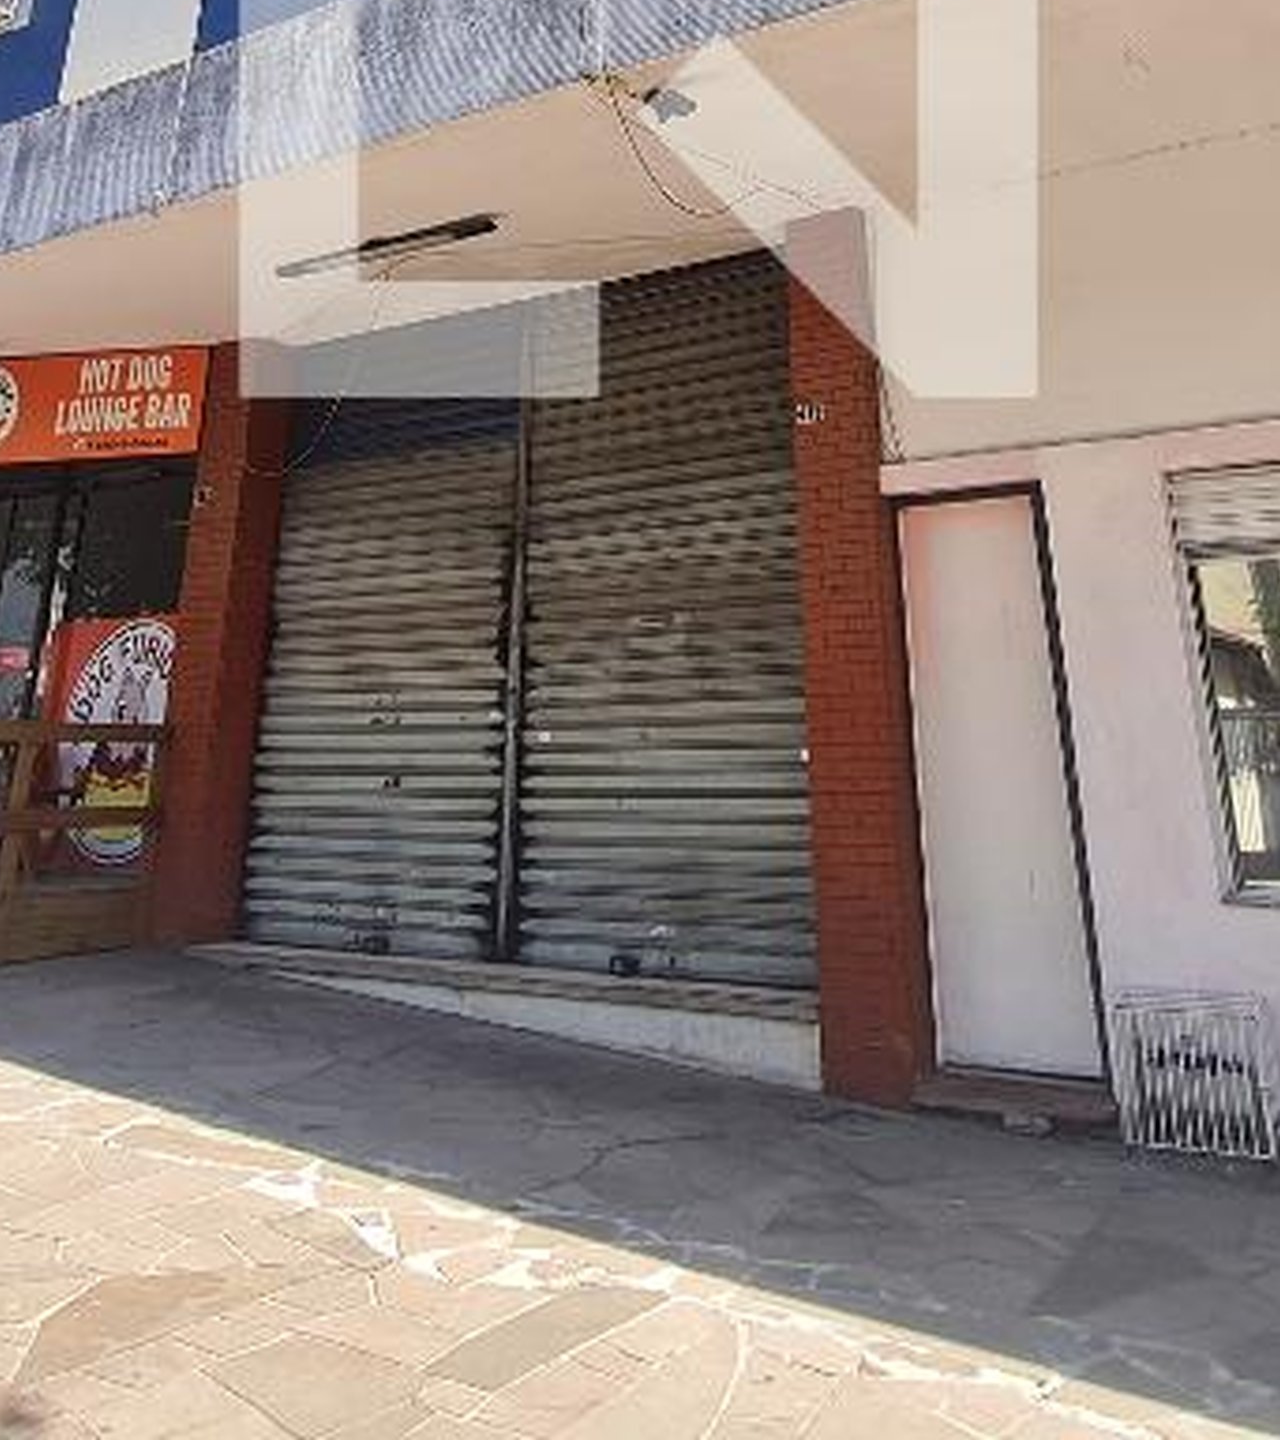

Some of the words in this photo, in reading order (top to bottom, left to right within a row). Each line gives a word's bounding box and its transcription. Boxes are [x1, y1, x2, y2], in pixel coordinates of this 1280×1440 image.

[80, 357, 122, 394] HOT
[126, 354, 173, 391] DOG
[54, 395, 144, 436] LOUNGE
[144, 392, 192, 429] BAR
